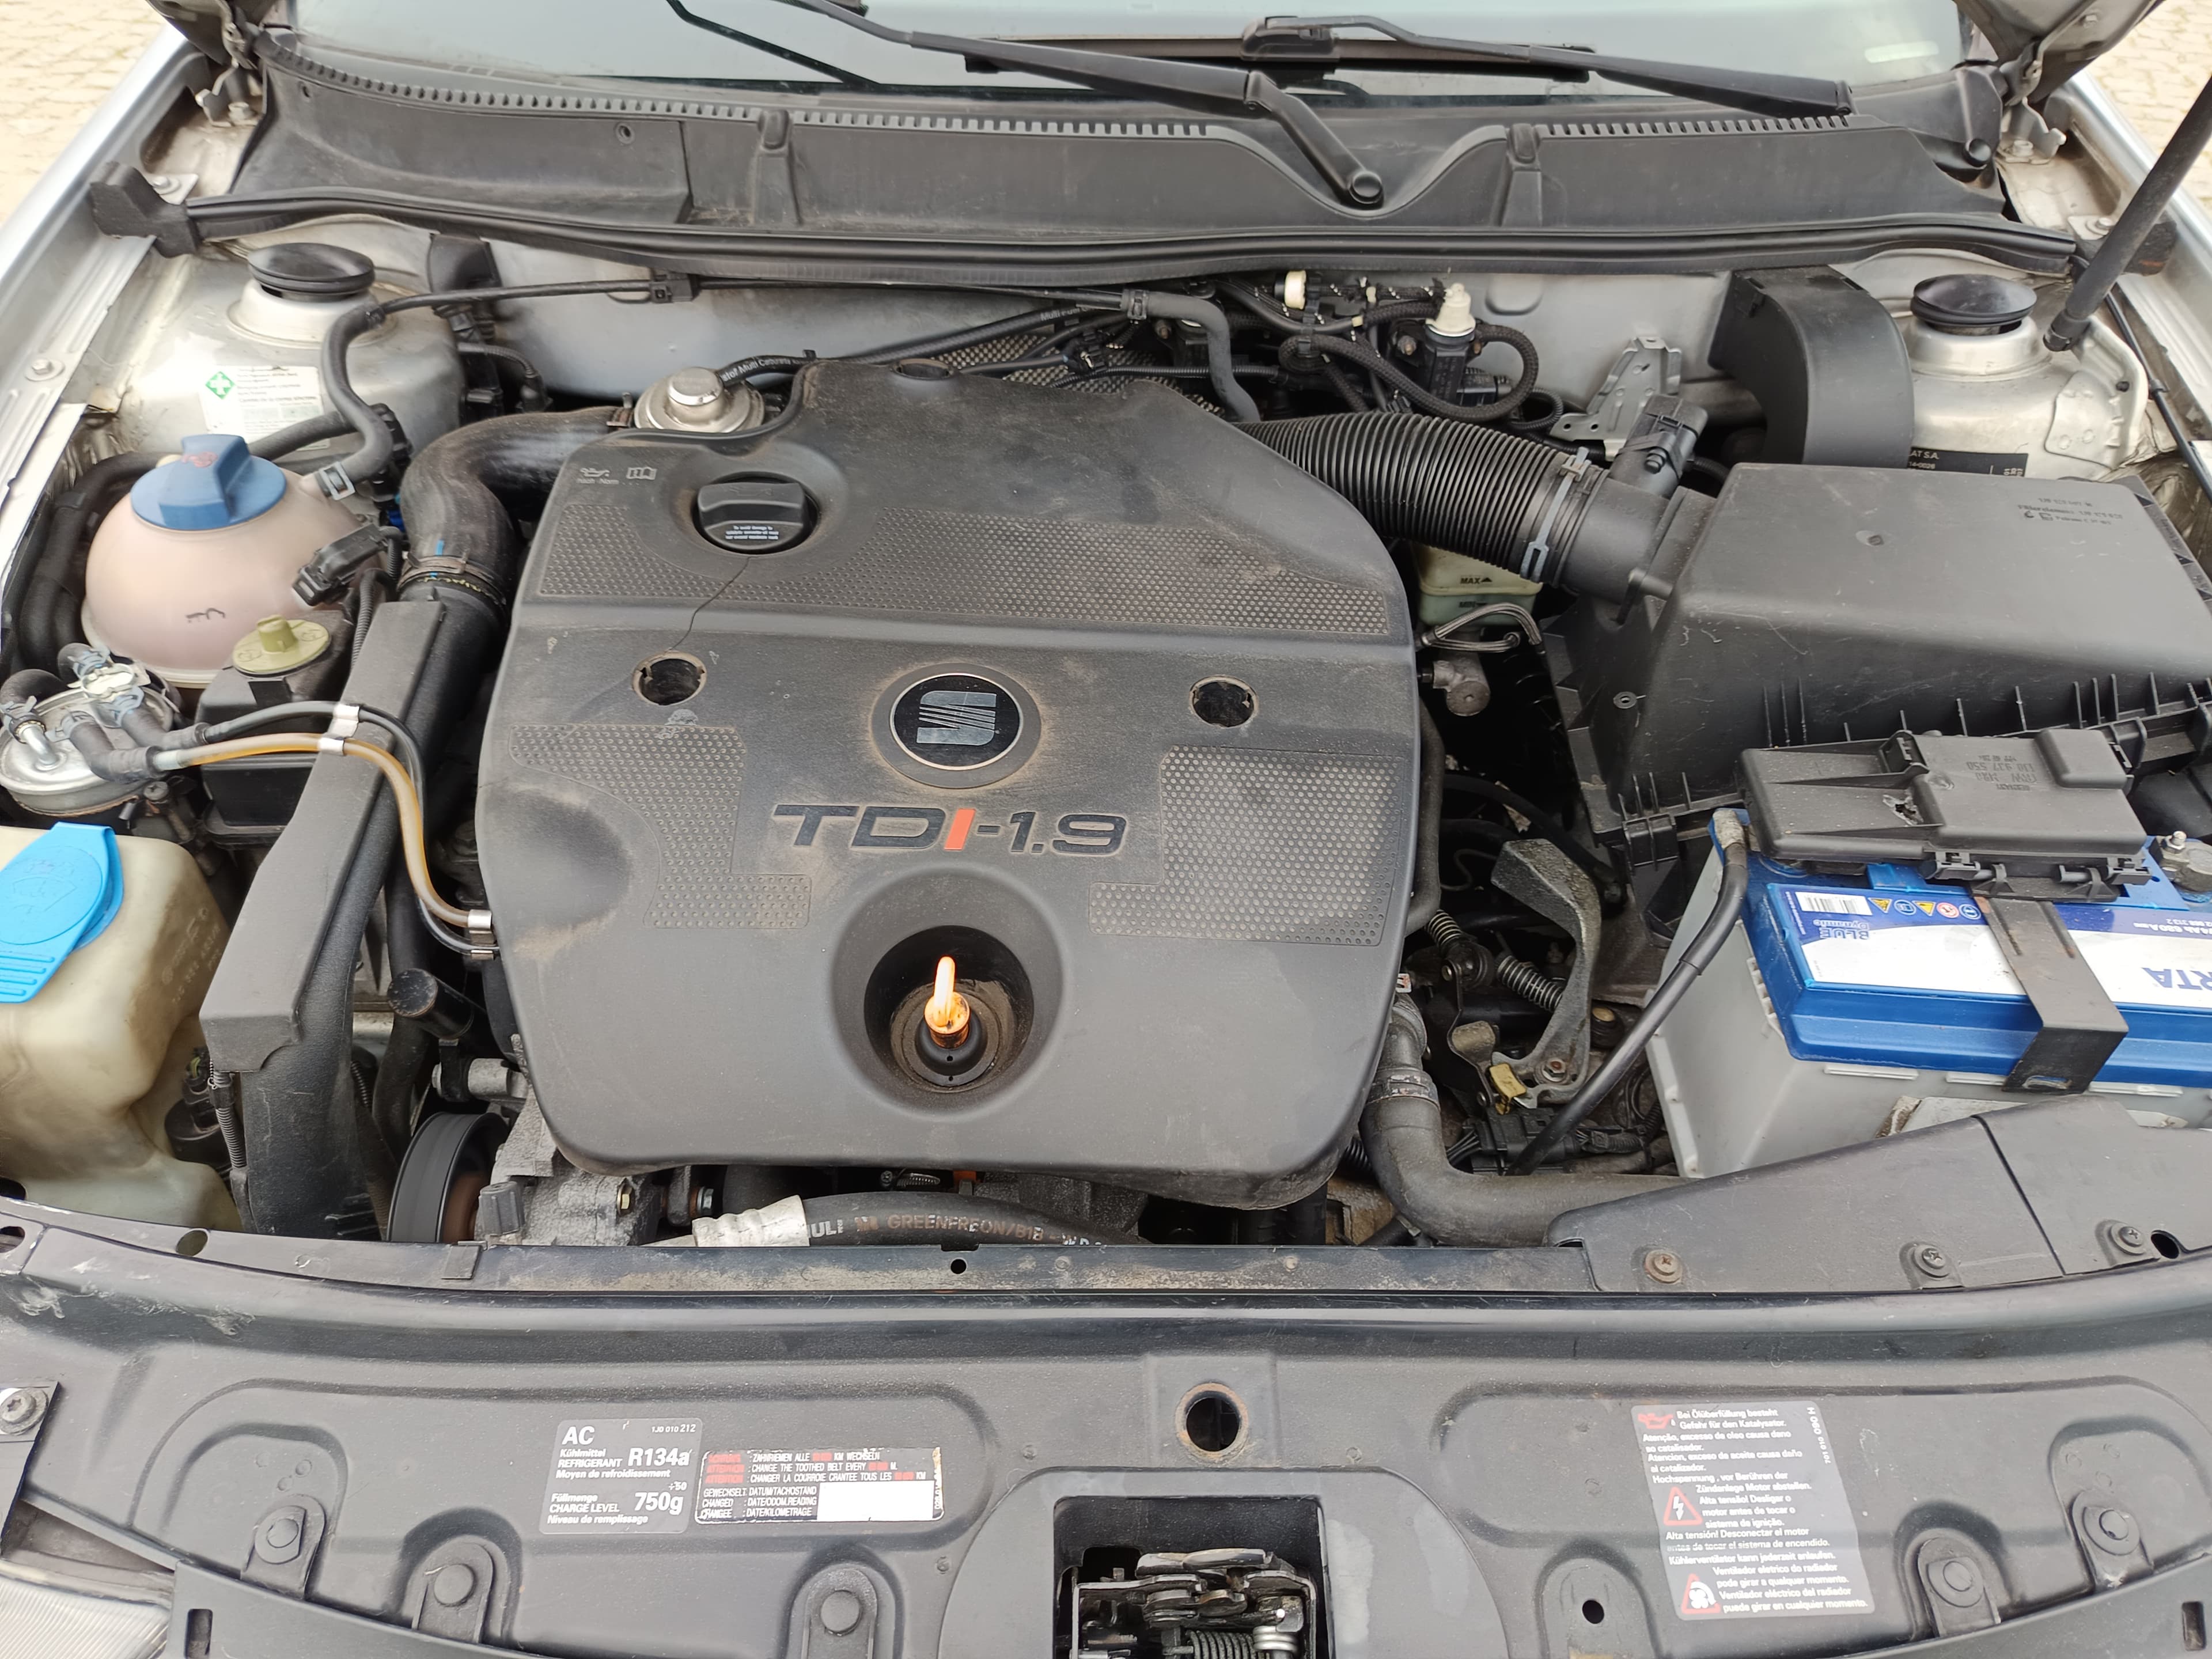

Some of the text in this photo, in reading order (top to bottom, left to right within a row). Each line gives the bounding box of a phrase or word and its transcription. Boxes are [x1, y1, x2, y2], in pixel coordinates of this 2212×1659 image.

[1819, 927, 1869, 941] BLUE
[1676, 1411, 1691, 1419] Bei
[1806, 1407, 1816, 1415] H
[680, 1424, 696, 1433] 212
[1680, 1421, 1707, 1430] Gefahr
[1708, 1421, 1720, 1429] für
[1738, 1419, 1786, 1429] Katalysator.
[562, 1426, 595, 1445] AC
[1714, 1431, 1725, 1440] de
[1771, 1430, 1791, 1438] dano
[560, 1448, 607, 1457] Kühlmittel
[627, 1447, 691, 1467] R134a
[795, 1452, 810, 1461] ALLE
[834, 1452, 843, 1460] KM
[1718, 1451, 1729, 1459] de
[1730, 1451, 1755, 1459] aceite
[558, 1459, 623, 1468] REFRIGERANT
[780, 1463, 793, 1472] THE
[796, 1463, 824, 1472] TOOTHED
[827, 1462, 843, 1471] BELT
[846, 1462, 866, 1471] EVERY
[556, 1469, 671, 1480] Moyen de refroidissement
[783, 1474, 791, 1483] LA
[794, 1473, 827, 1483] COURROIE
[860, 1472, 877, 1481] TOUS
[880, 1472, 892, 1480] LES
[916, 1471, 926, 1480] KM
[1734, 1472, 1774, 1481] Berühren
[1774, 1471, 1788, 1479] der
[1695, 1482, 1812, 1494] Zündanlage Motor abstellen.
[551, 1493, 598, 1502] Füllmenge
[634, 1491, 684, 1515] 750g
[702, 1498, 734, 1508] CHANGED
[1699, 1496, 1717, 1505] Alta
[1749, 1494, 1784, 1504] Desligar
[550, 1503, 620, 1513] CHARGE LEVEL
[1702, 1509, 1728, 1517] motor
[1729, 1508, 1753, 1516] antes
[1754, 1506, 1765, 1514] de
[547, 1514, 649, 1525] Niveau de remplissage
[1705, 1520, 1739, 1529] sistema
[1740, 1518, 1751, 1527] de
[1666, 1528, 1809, 1540] Alta tensión! Desconectar el motor
[1666, 1544, 1691, 1552] antes
[1692, 1542, 1704, 1551] de
[1728, 1541, 1736, 1550] el
[1737, 1540, 1771, 1549] sistema
[1772, 1540, 1784, 1548] de
[1785, 1538, 1830, 1548] encendido.
[1668, 1555, 1736, 1565] Kühlerventilator
[1736, 1554, 1759, 1563] kann
[1712, 1565, 1756, 1575] Ventilador
[1790, 1564, 1802, 1573] do
[1803, 1563, 1838, 1572] radiador
[1716, 1578, 1738, 1589] pode
[1739, 1578, 1760, 1588] girar
[1768, 1576, 1805, 1587] qualquer
[1806, 1575, 1850, 1585] momento.
[1718, 1590, 1763, 1600] Ventilador
[1802, 1588, 1816, 1597] del
[1816, 1586, 1852, 1596] radiador
[1723, 1603, 1750, 1613] puede
[1751, 1602, 1771, 1613] girar
[1786, 1600, 1824, 1611] cualquier
[1825, 1599, 1869, 1608] momento.
